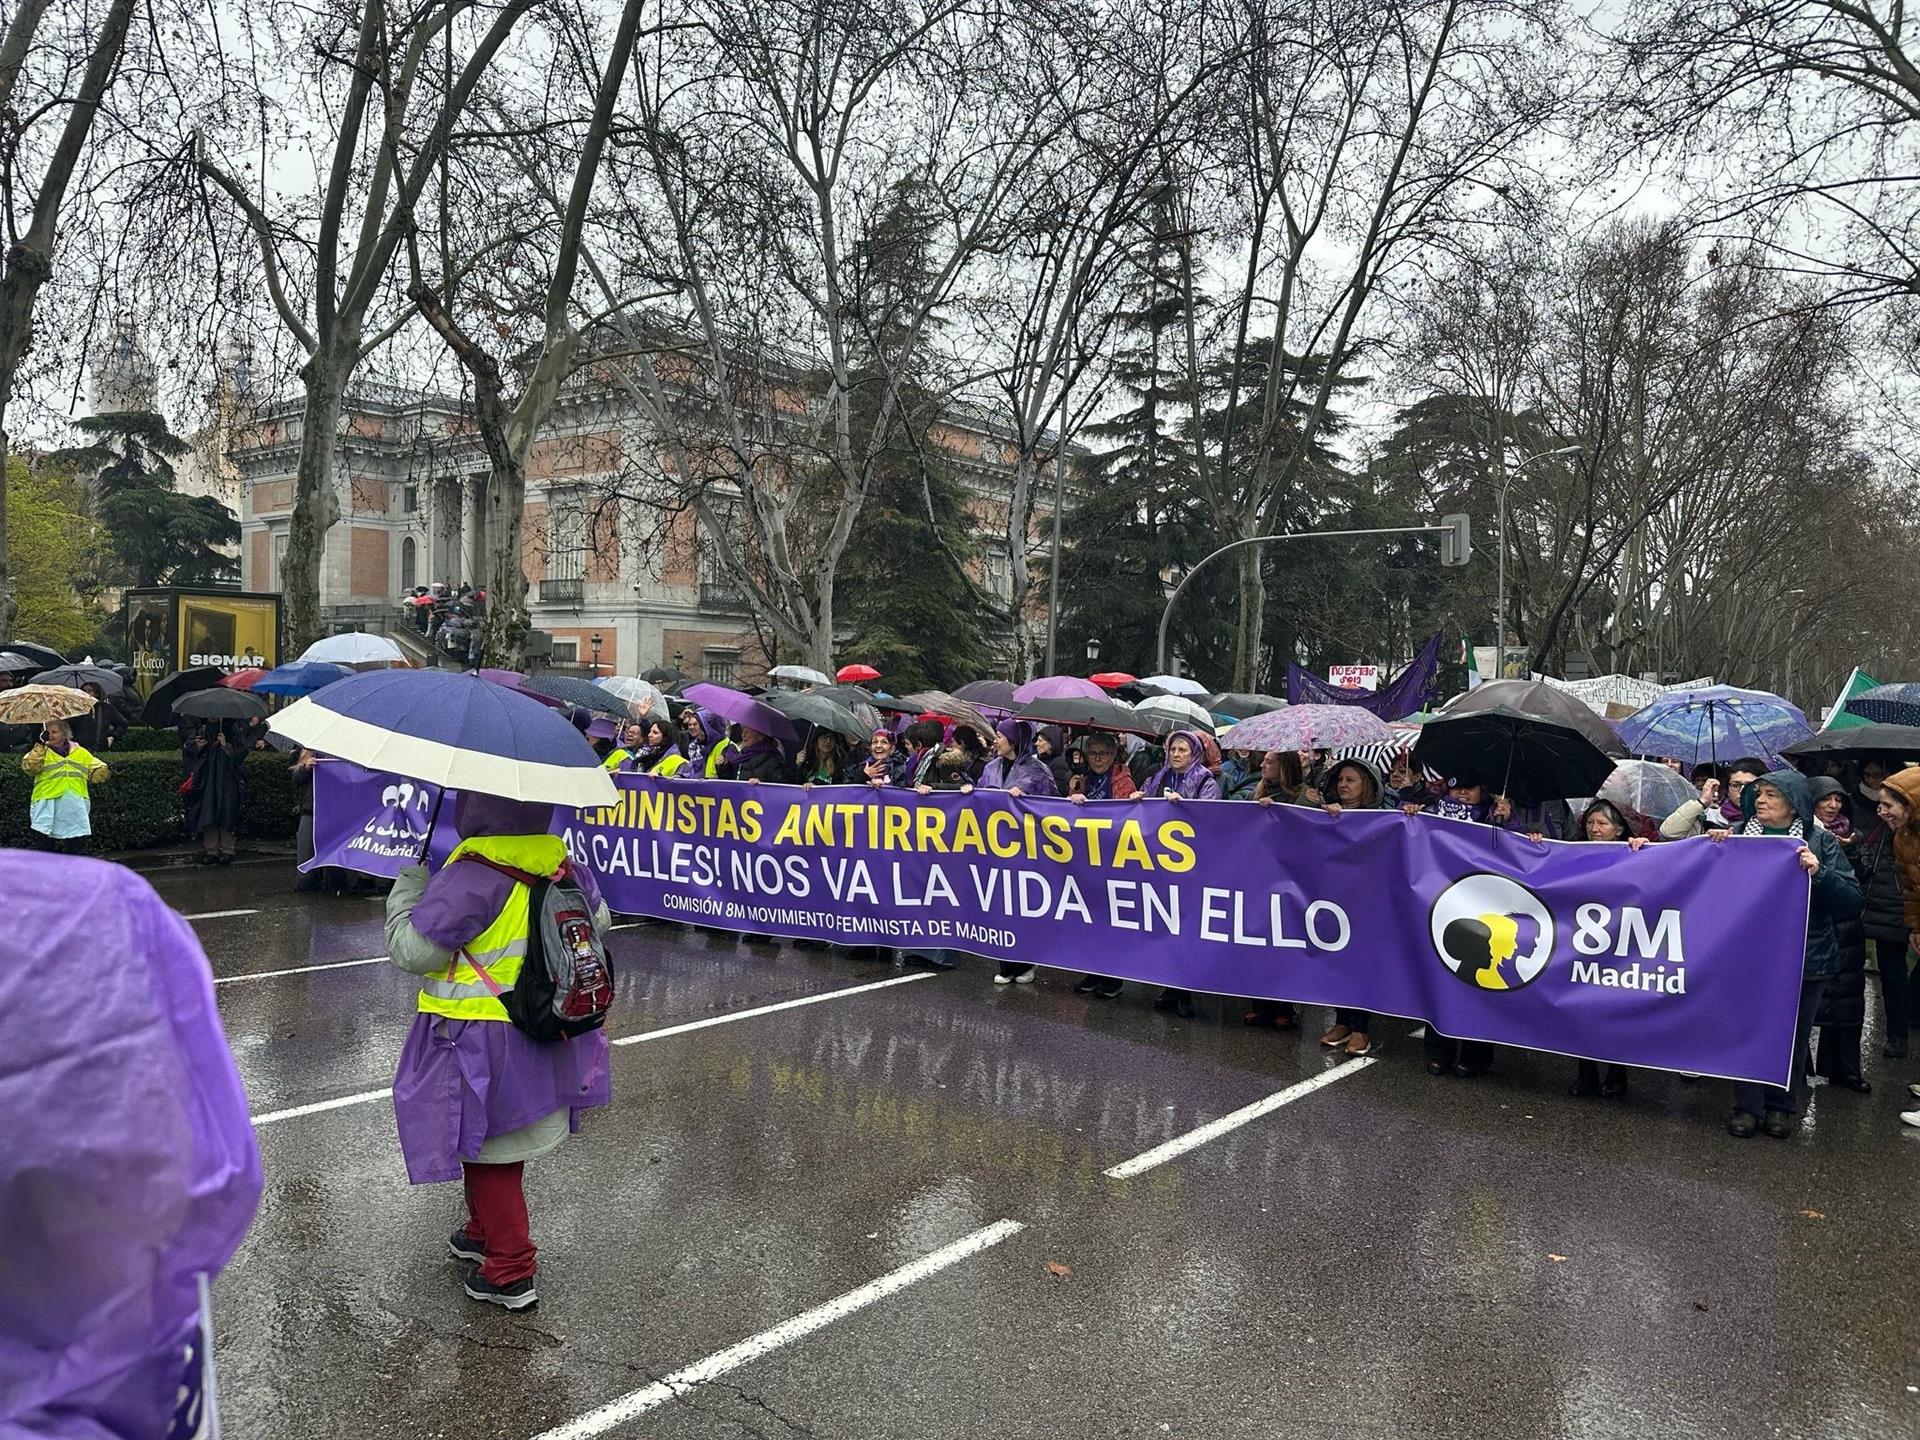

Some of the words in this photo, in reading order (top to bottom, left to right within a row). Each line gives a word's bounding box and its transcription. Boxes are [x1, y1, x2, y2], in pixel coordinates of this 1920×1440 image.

[141, 651, 165, 669] Greco
[189, 654, 265, 667] SIGMAR
[370, 842, 414, 857] Madrid
[575, 789, 763, 843] MINISTAS
[773, 804, 1196, 873] ANTIRRACISTAS
[592, 834, 723, 888] CALLES!
[731, 849, 811, 898] NOS
[820, 856, 879, 905] VA
[892, 861, 960, 907] LA
[969, 863, 1093, 924] VIDA
[1106, 879, 1180, 936] EN
[1200, 886, 1351, 952] ELLO
[663, 893, 723, 916] COMISIÓN
[725, 901, 746, 919] 8M
[747, 905, 835, 929] MOVIMIENTO
[836, 915, 924, 936] FEMINISTA
[928, 920, 952, 937] DE
[955, 921, 1016, 947] MADRID
[1572, 903, 1684, 962] 8M
[1570, 961, 1686, 994] Madrid
